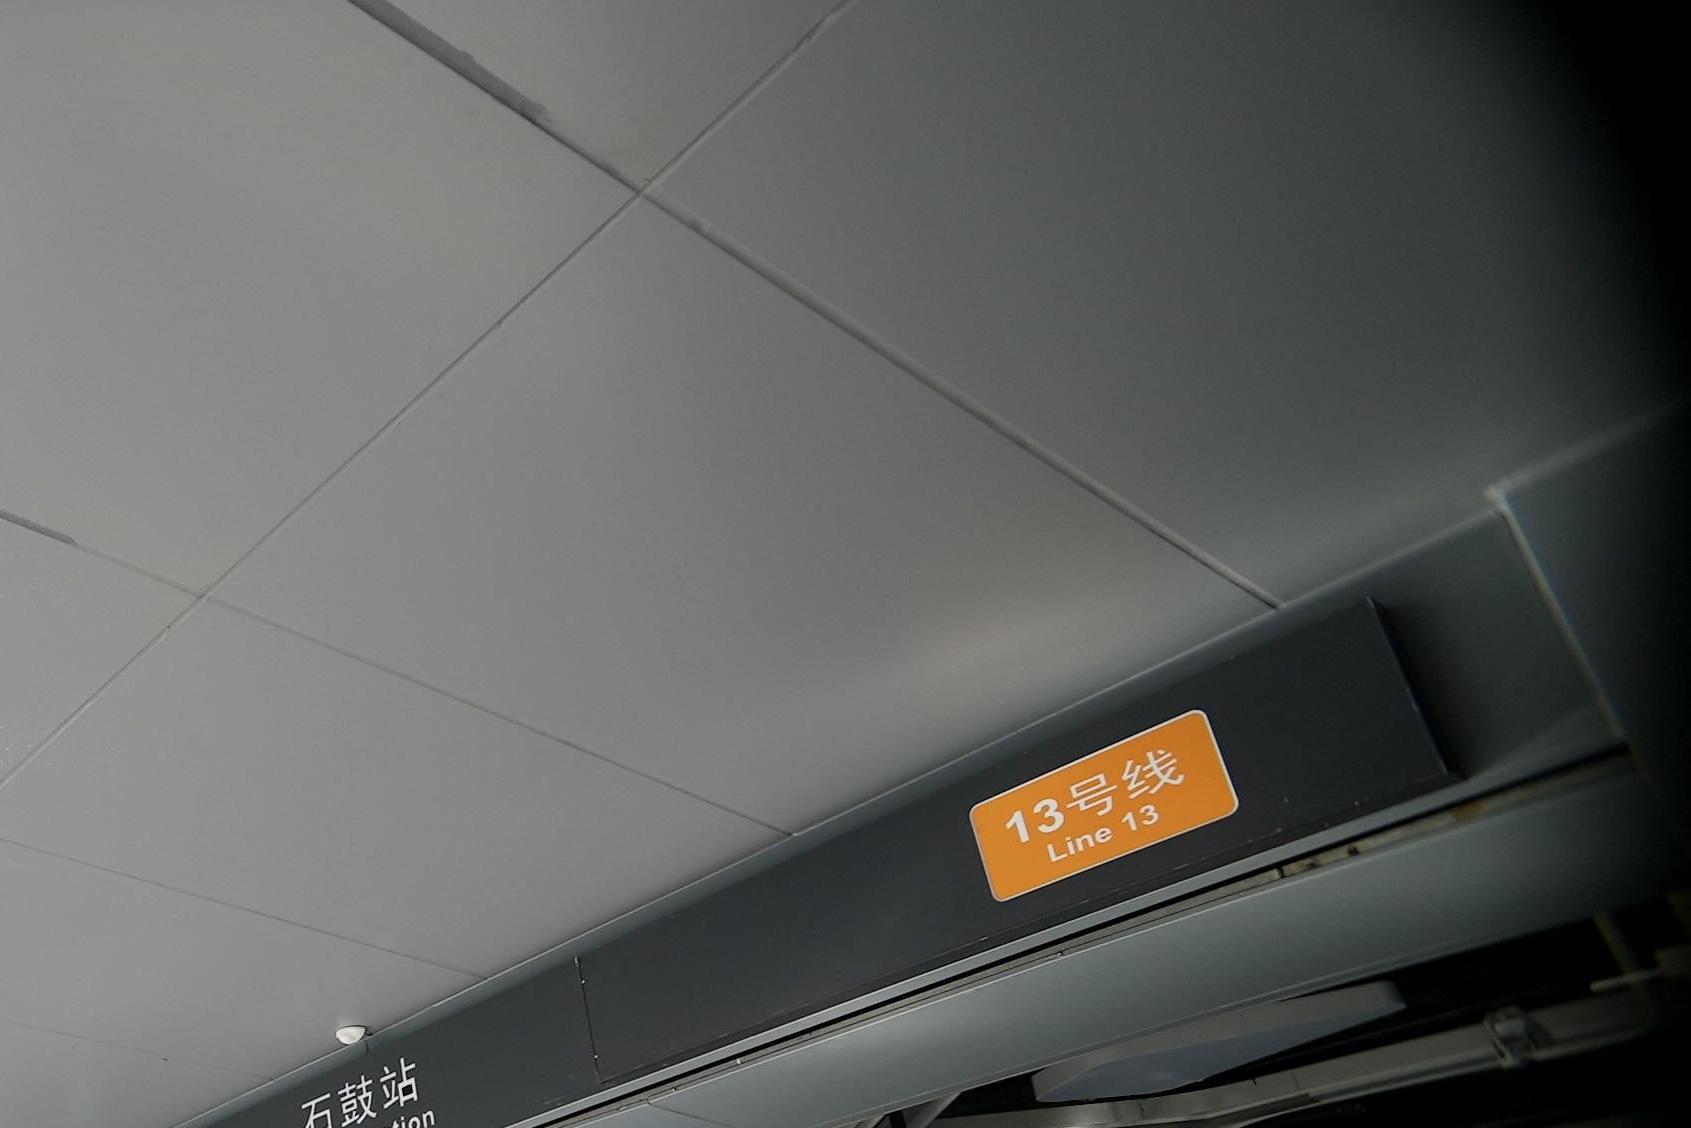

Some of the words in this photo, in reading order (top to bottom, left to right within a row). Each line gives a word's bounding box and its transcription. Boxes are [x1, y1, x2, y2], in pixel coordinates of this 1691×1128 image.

[1005, 749, 1186, 843] 13号线
[1047, 825, 1113, 863] Line
[1122, 803, 1160, 832] 13
